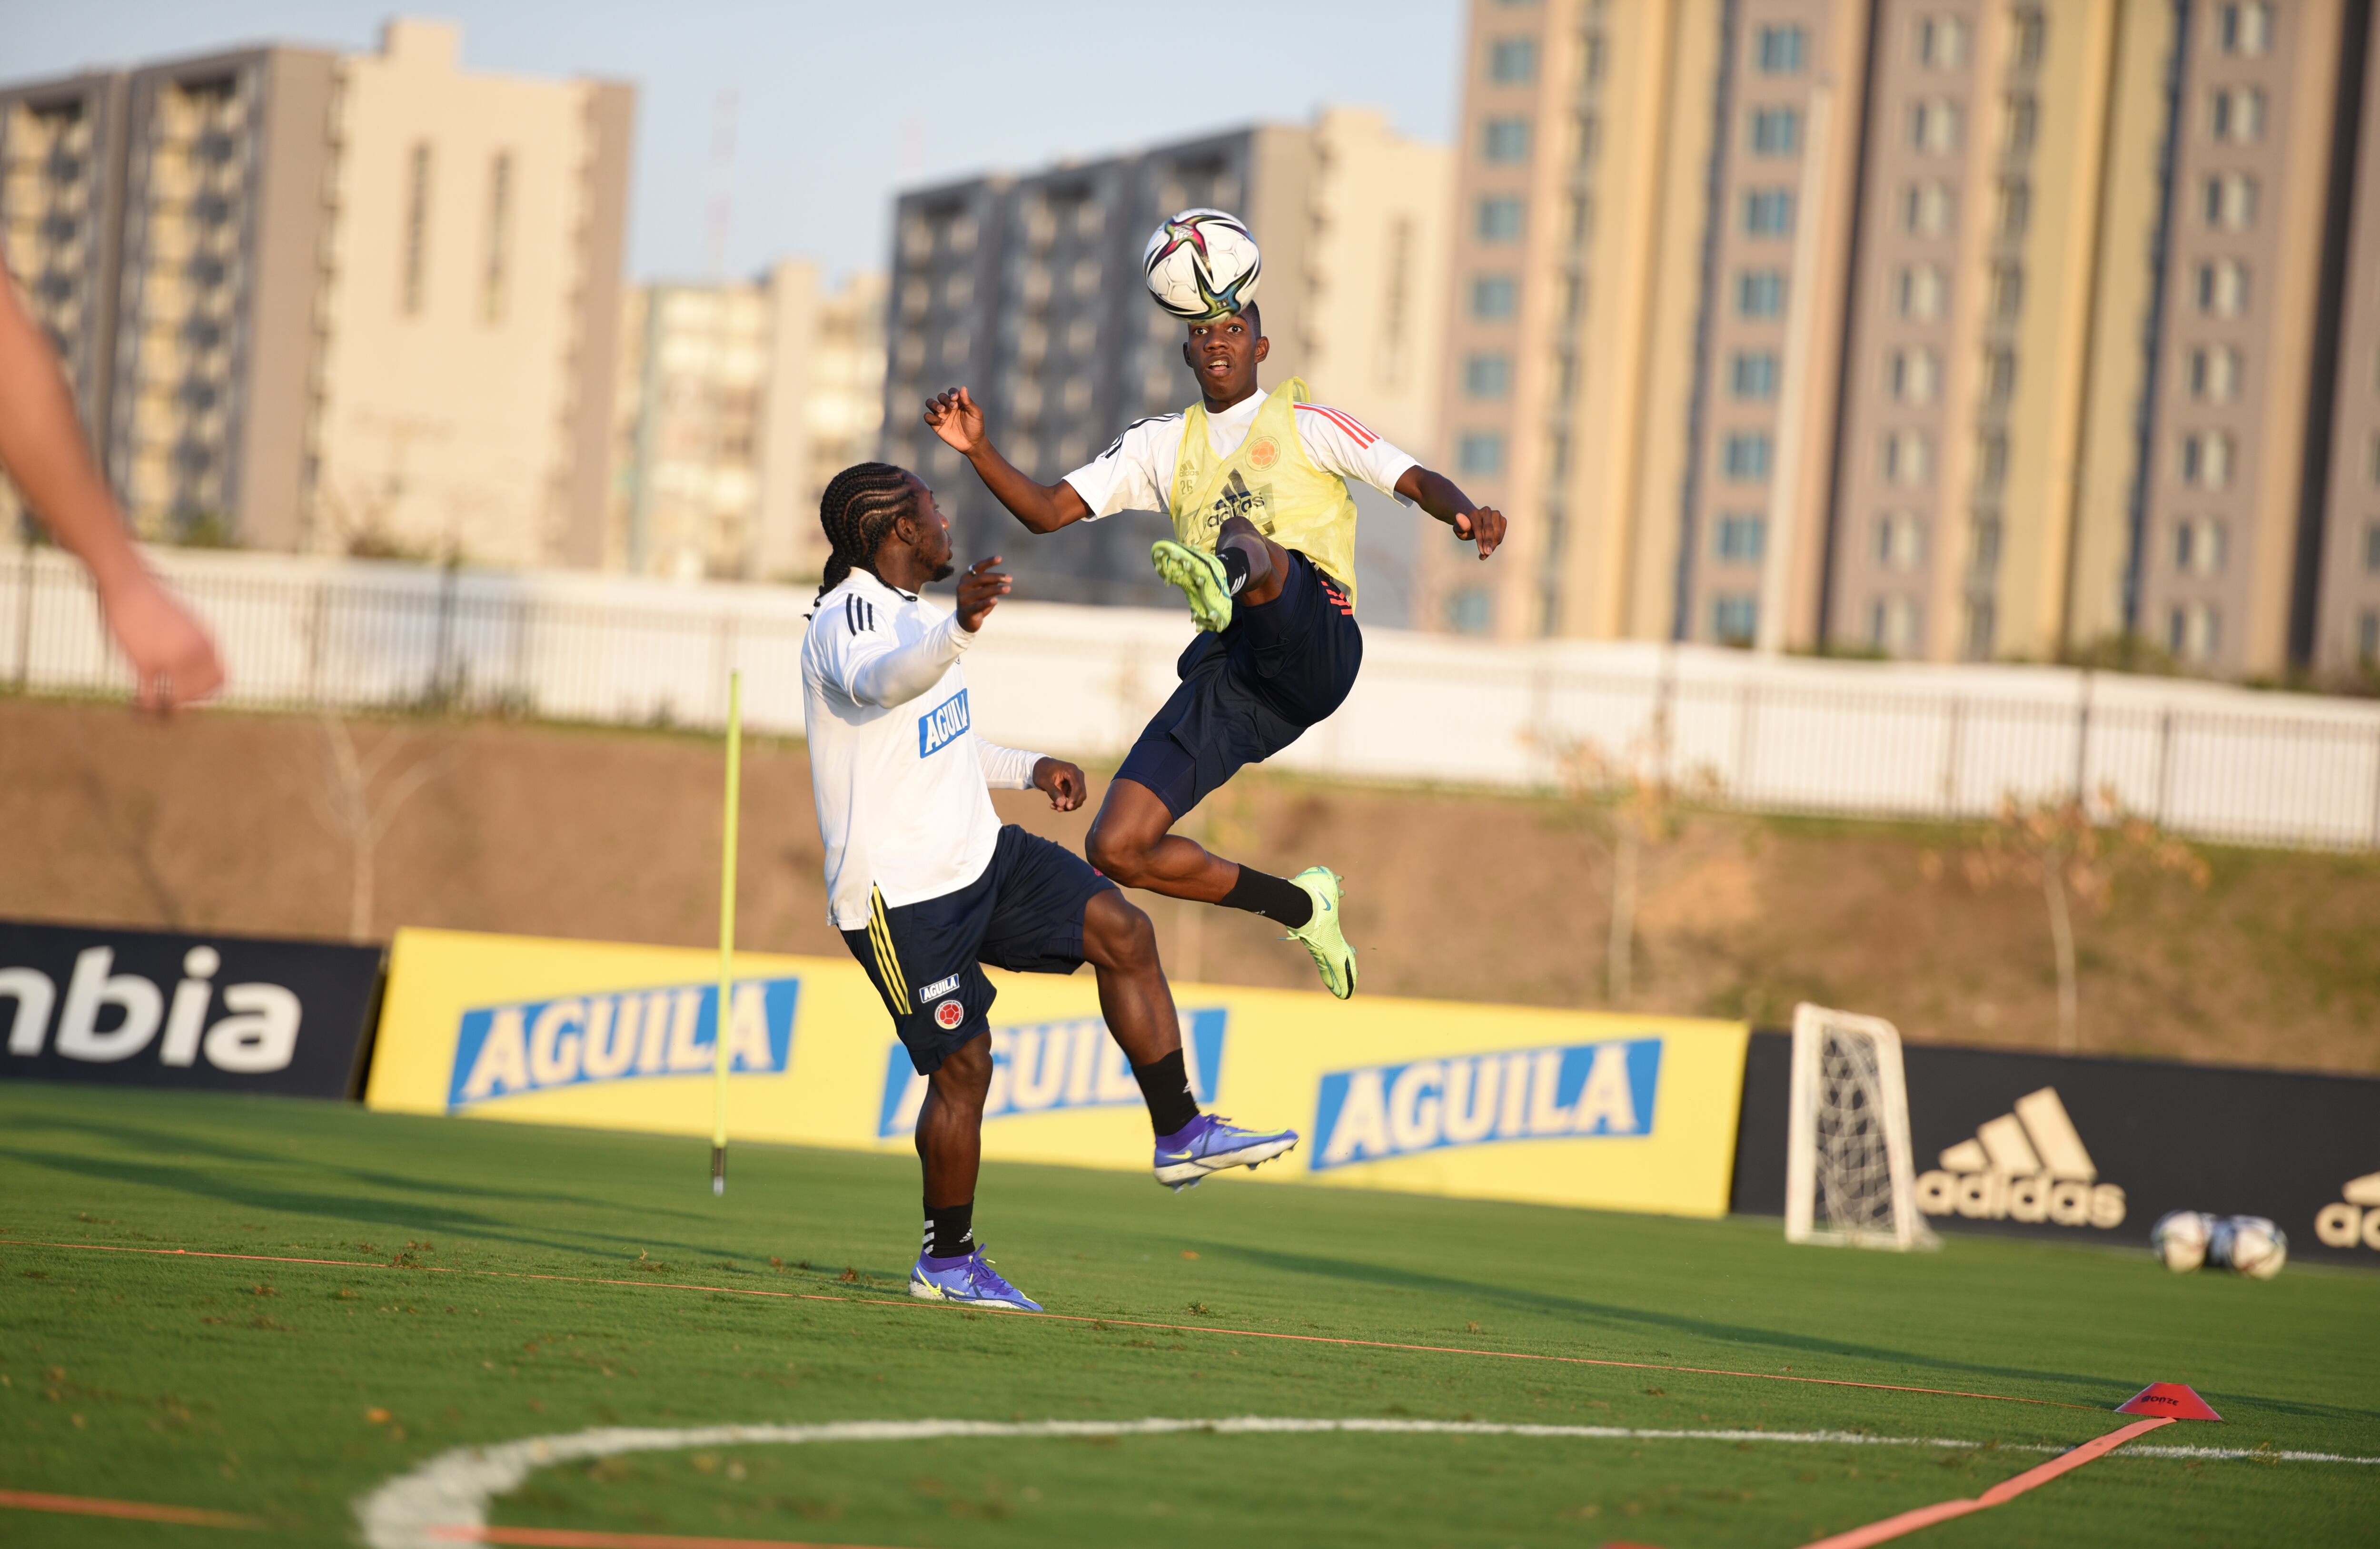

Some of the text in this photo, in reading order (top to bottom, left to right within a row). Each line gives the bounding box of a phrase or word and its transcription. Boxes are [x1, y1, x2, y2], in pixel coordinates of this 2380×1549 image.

[1180, 480, 1193, 495] 26
[924, 977, 957, 1000] AGUILA
[460, 981, 775, 1099] AGUILA
[1320, 1042, 1639, 1165] AGUILA
[1914, 1169, 2127, 1229] adidas
